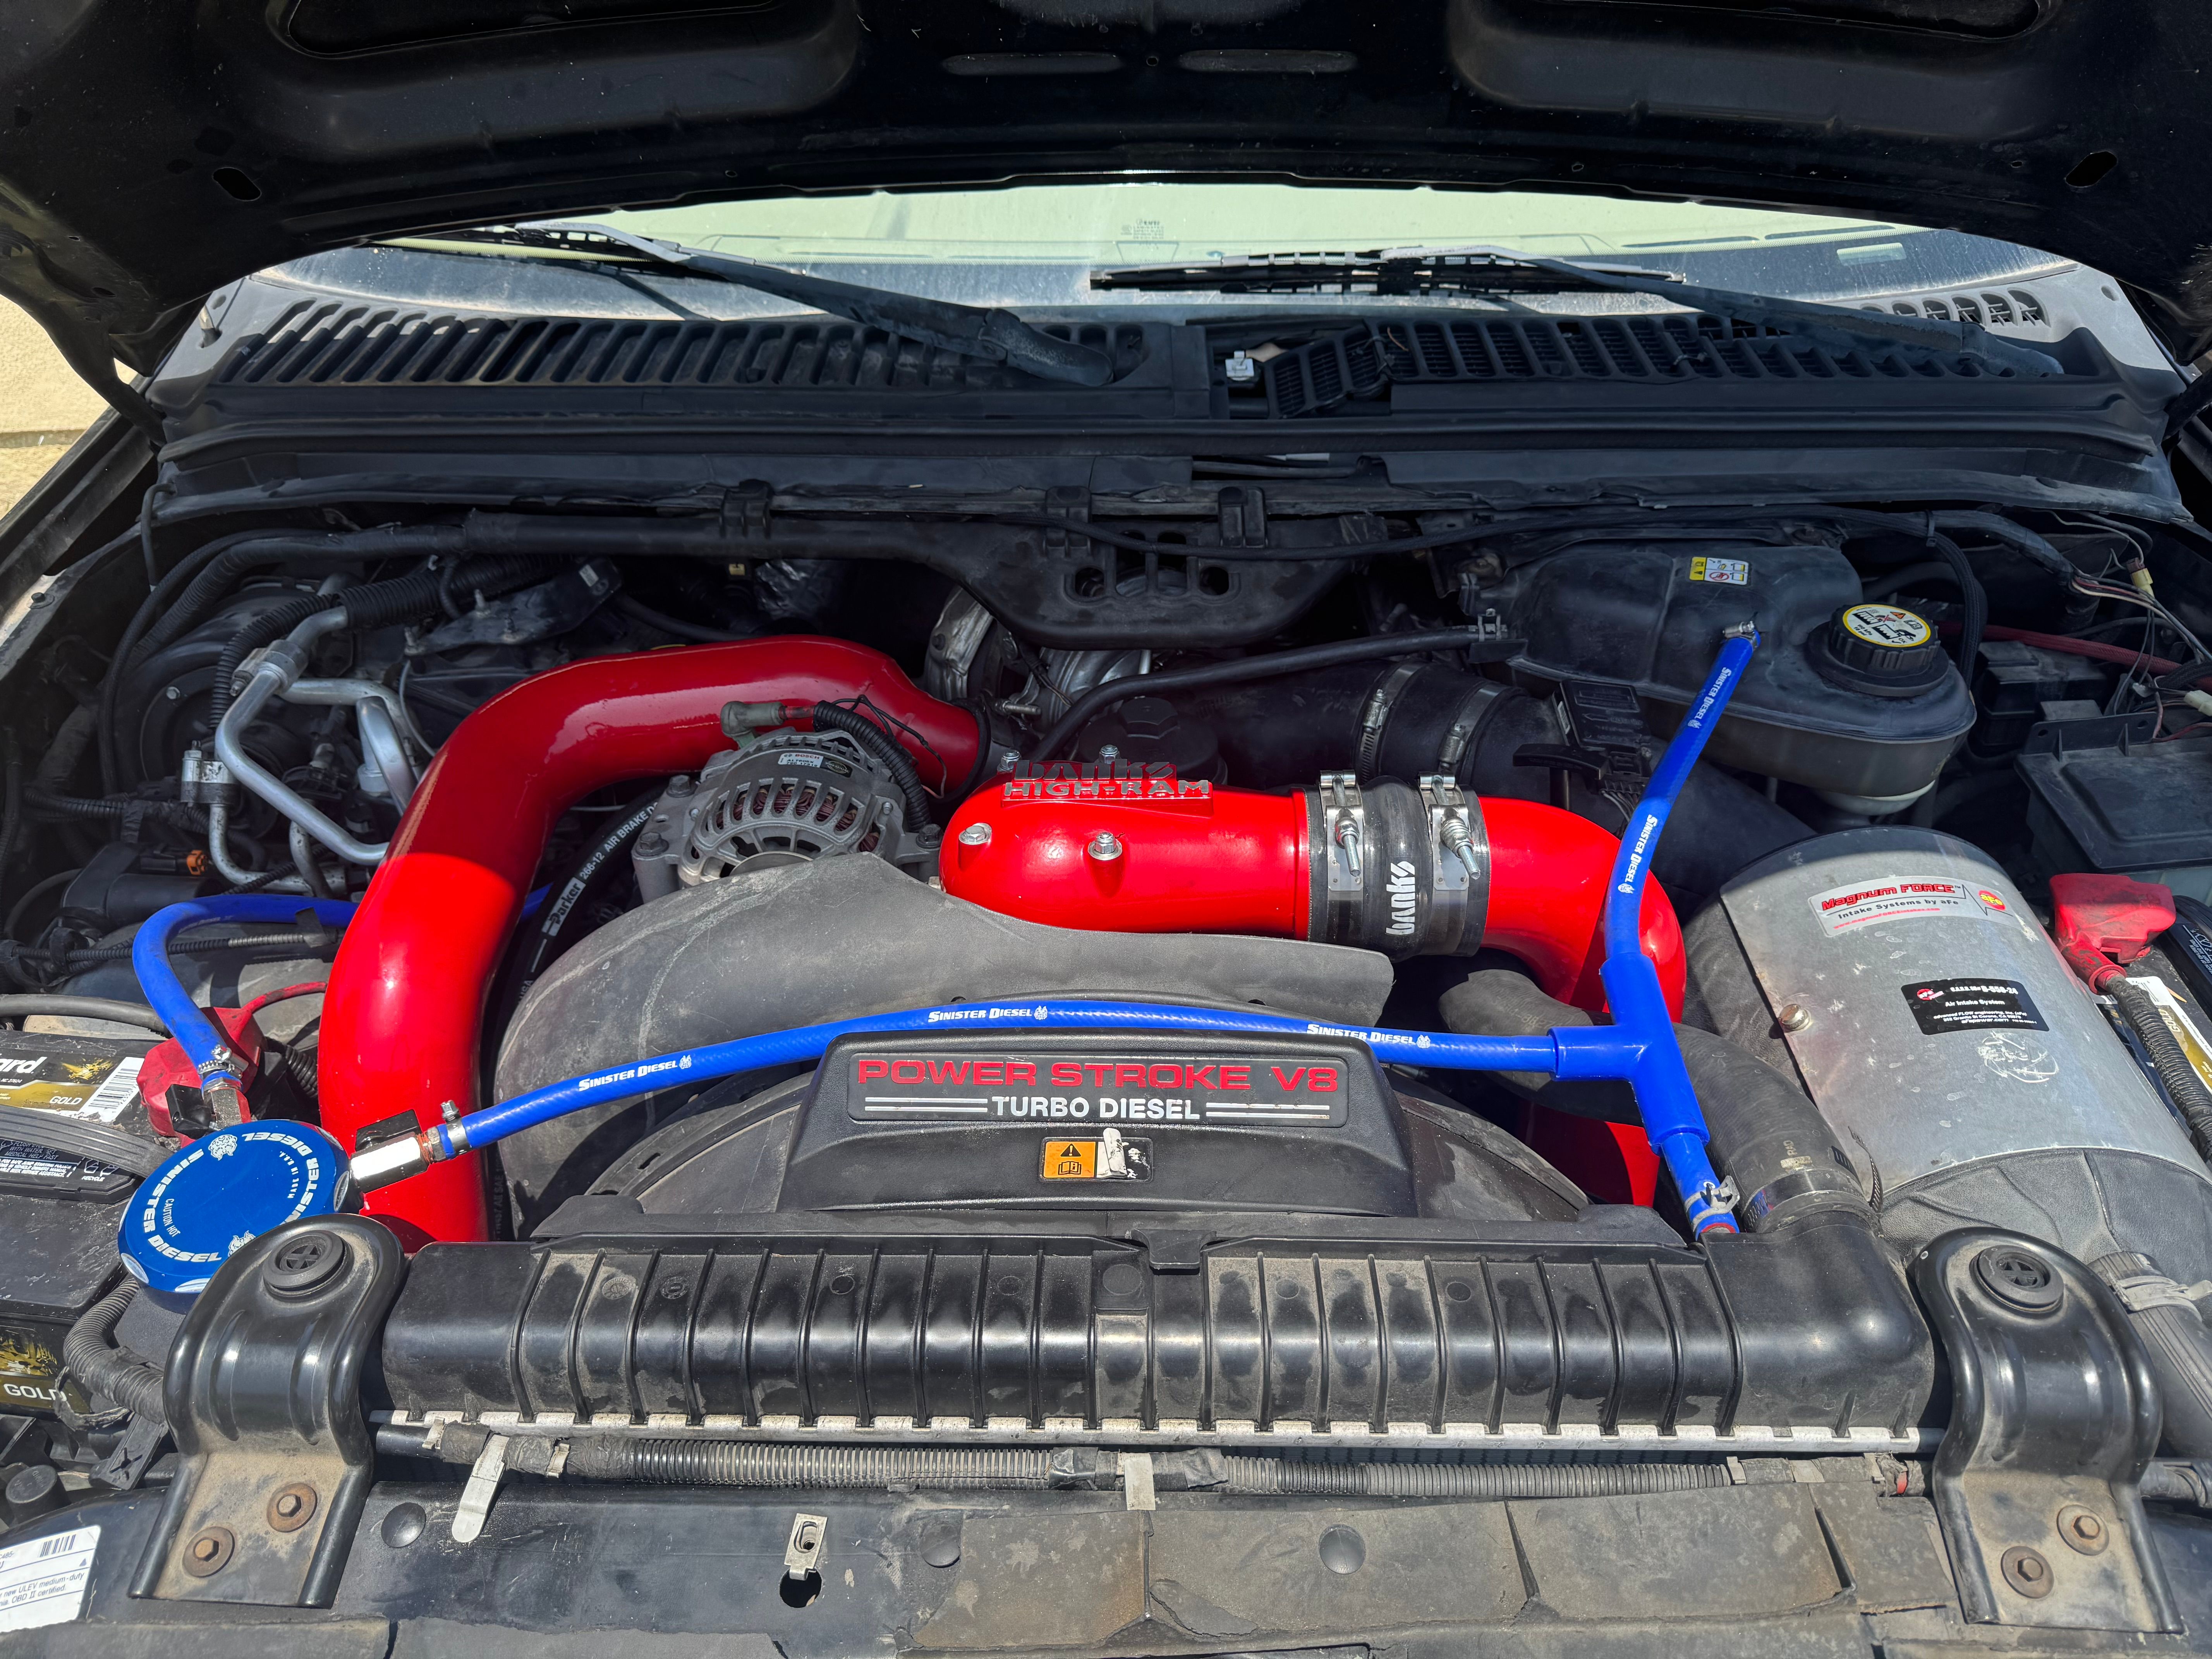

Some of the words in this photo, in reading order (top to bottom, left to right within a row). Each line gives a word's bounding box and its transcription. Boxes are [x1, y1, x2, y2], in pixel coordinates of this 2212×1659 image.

[1708, 667, 1732, 699] SINISTER
[1696, 696, 1715, 720] DIESEL
[1004, 780, 1209, 796] HIGH-RAM
[1634, 814, 1658, 854] SINISTER
[549, 882, 581, 925] Parker
[580, 852, 605, 880] 266-12
[604, 835, 620, 852] AIR
[617, 811, 649, 838] BRAKE
[1625, 853, 1642, 883] DIESEL
[1822, 886, 1898, 911] Magnum
[1838, 906, 1872, 919] Intake
[1876, 899, 1922, 910] Systems
[1980, 893, 2004, 906] aFe
[929, 1009, 987, 1024] SINISTER
[989, 1006, 1032, 1019] DIESEL
[2158, 1008, 2181, 1032] GOLD
[1307, 1024, 1367, 1040] SINISTER
[1370, 1031, 1417, 1045] DIESEL
[579, 1070, 635, 1092] SINISTER
[638, 1059, 678, 1076] DIESEL
[858, 1059, 1036, 1087] POWER
[1050, 1063, 1250, 1090] STROKE
[1271, 1066, 1338, 1092] V8
[49, 1096, 83, 1105] GOLD
[991, 1096, 1089, 1118] TURBO
[1098, 1097, 1200, 1120] DIESEL
[242, 1132, 313, 1156] DIESEL
[291, 1167, 299, 1175] IN
[143, 1149, 204, 1233] SINISTER
[287, 1178, 299, 1199] MADE
[163, 1198, 175, 1226] CAUTION
[167, 1225, 181, 1237] HOT
[148, 1234, 222, 1262] DIESEL
[4, 1589, 17, 1597] new
[18, 1582, 37, 1594] ULEV
[38, 1572, 85, 1589] medium-duty
[12, 1594, 27, 1604] OBD
